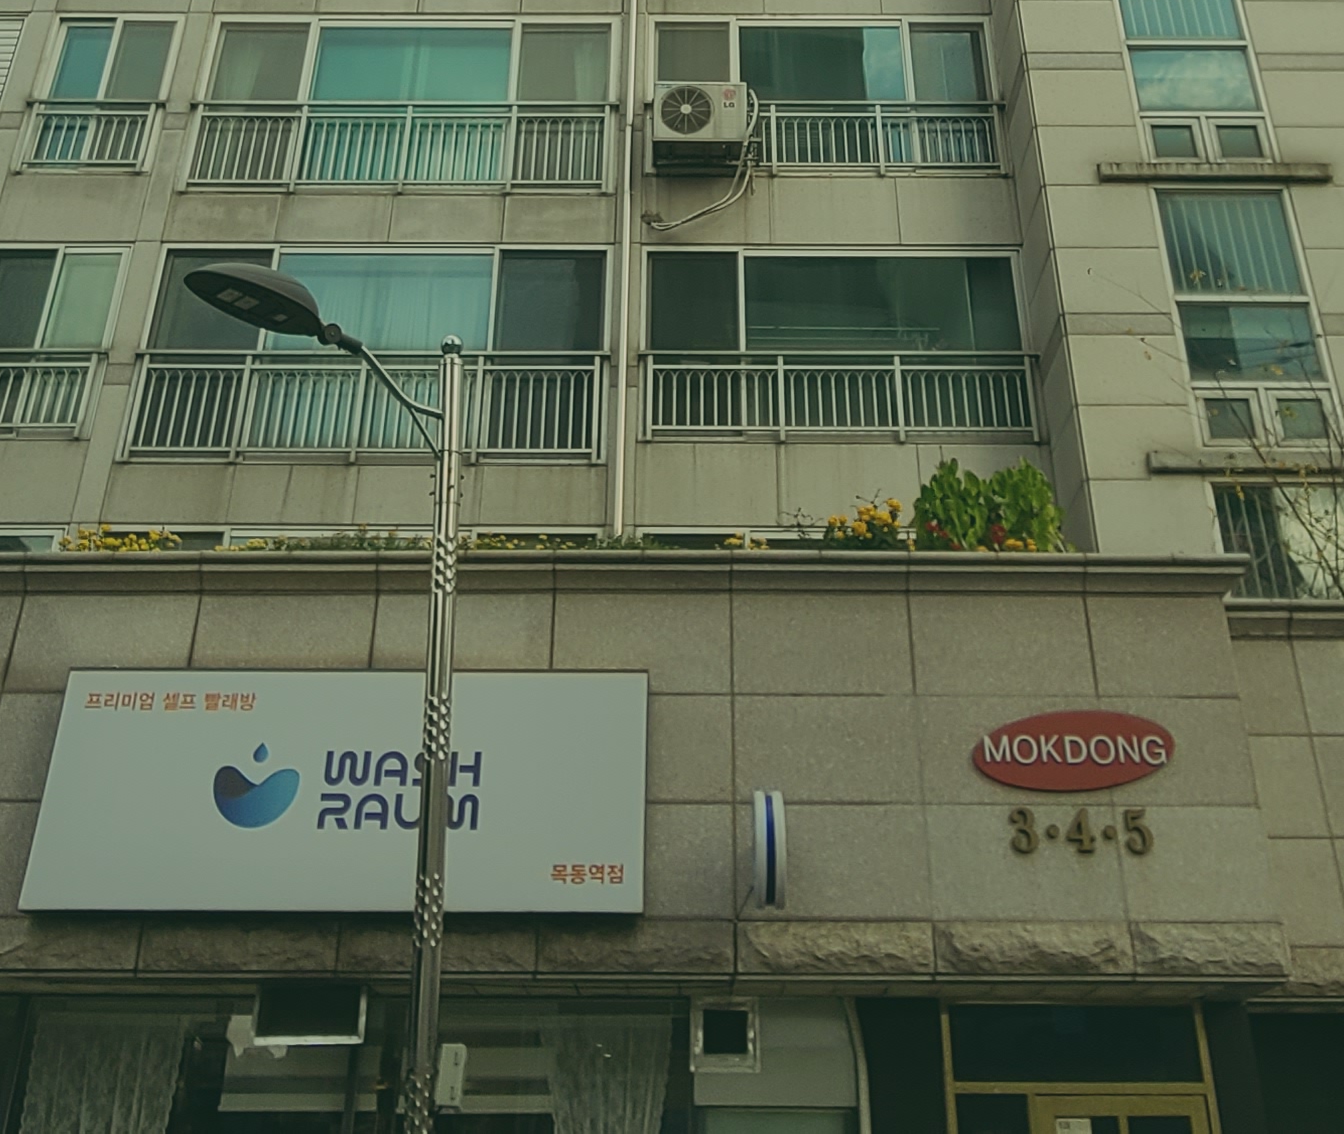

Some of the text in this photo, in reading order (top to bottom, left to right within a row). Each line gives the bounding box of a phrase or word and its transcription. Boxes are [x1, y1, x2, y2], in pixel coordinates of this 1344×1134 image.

[84, 692, 257, 711] 프리미엄 셀프 빨래방
[982, 734, 1169, 765] MOKDONG
[551, 864, 624, 885] 목동역점
